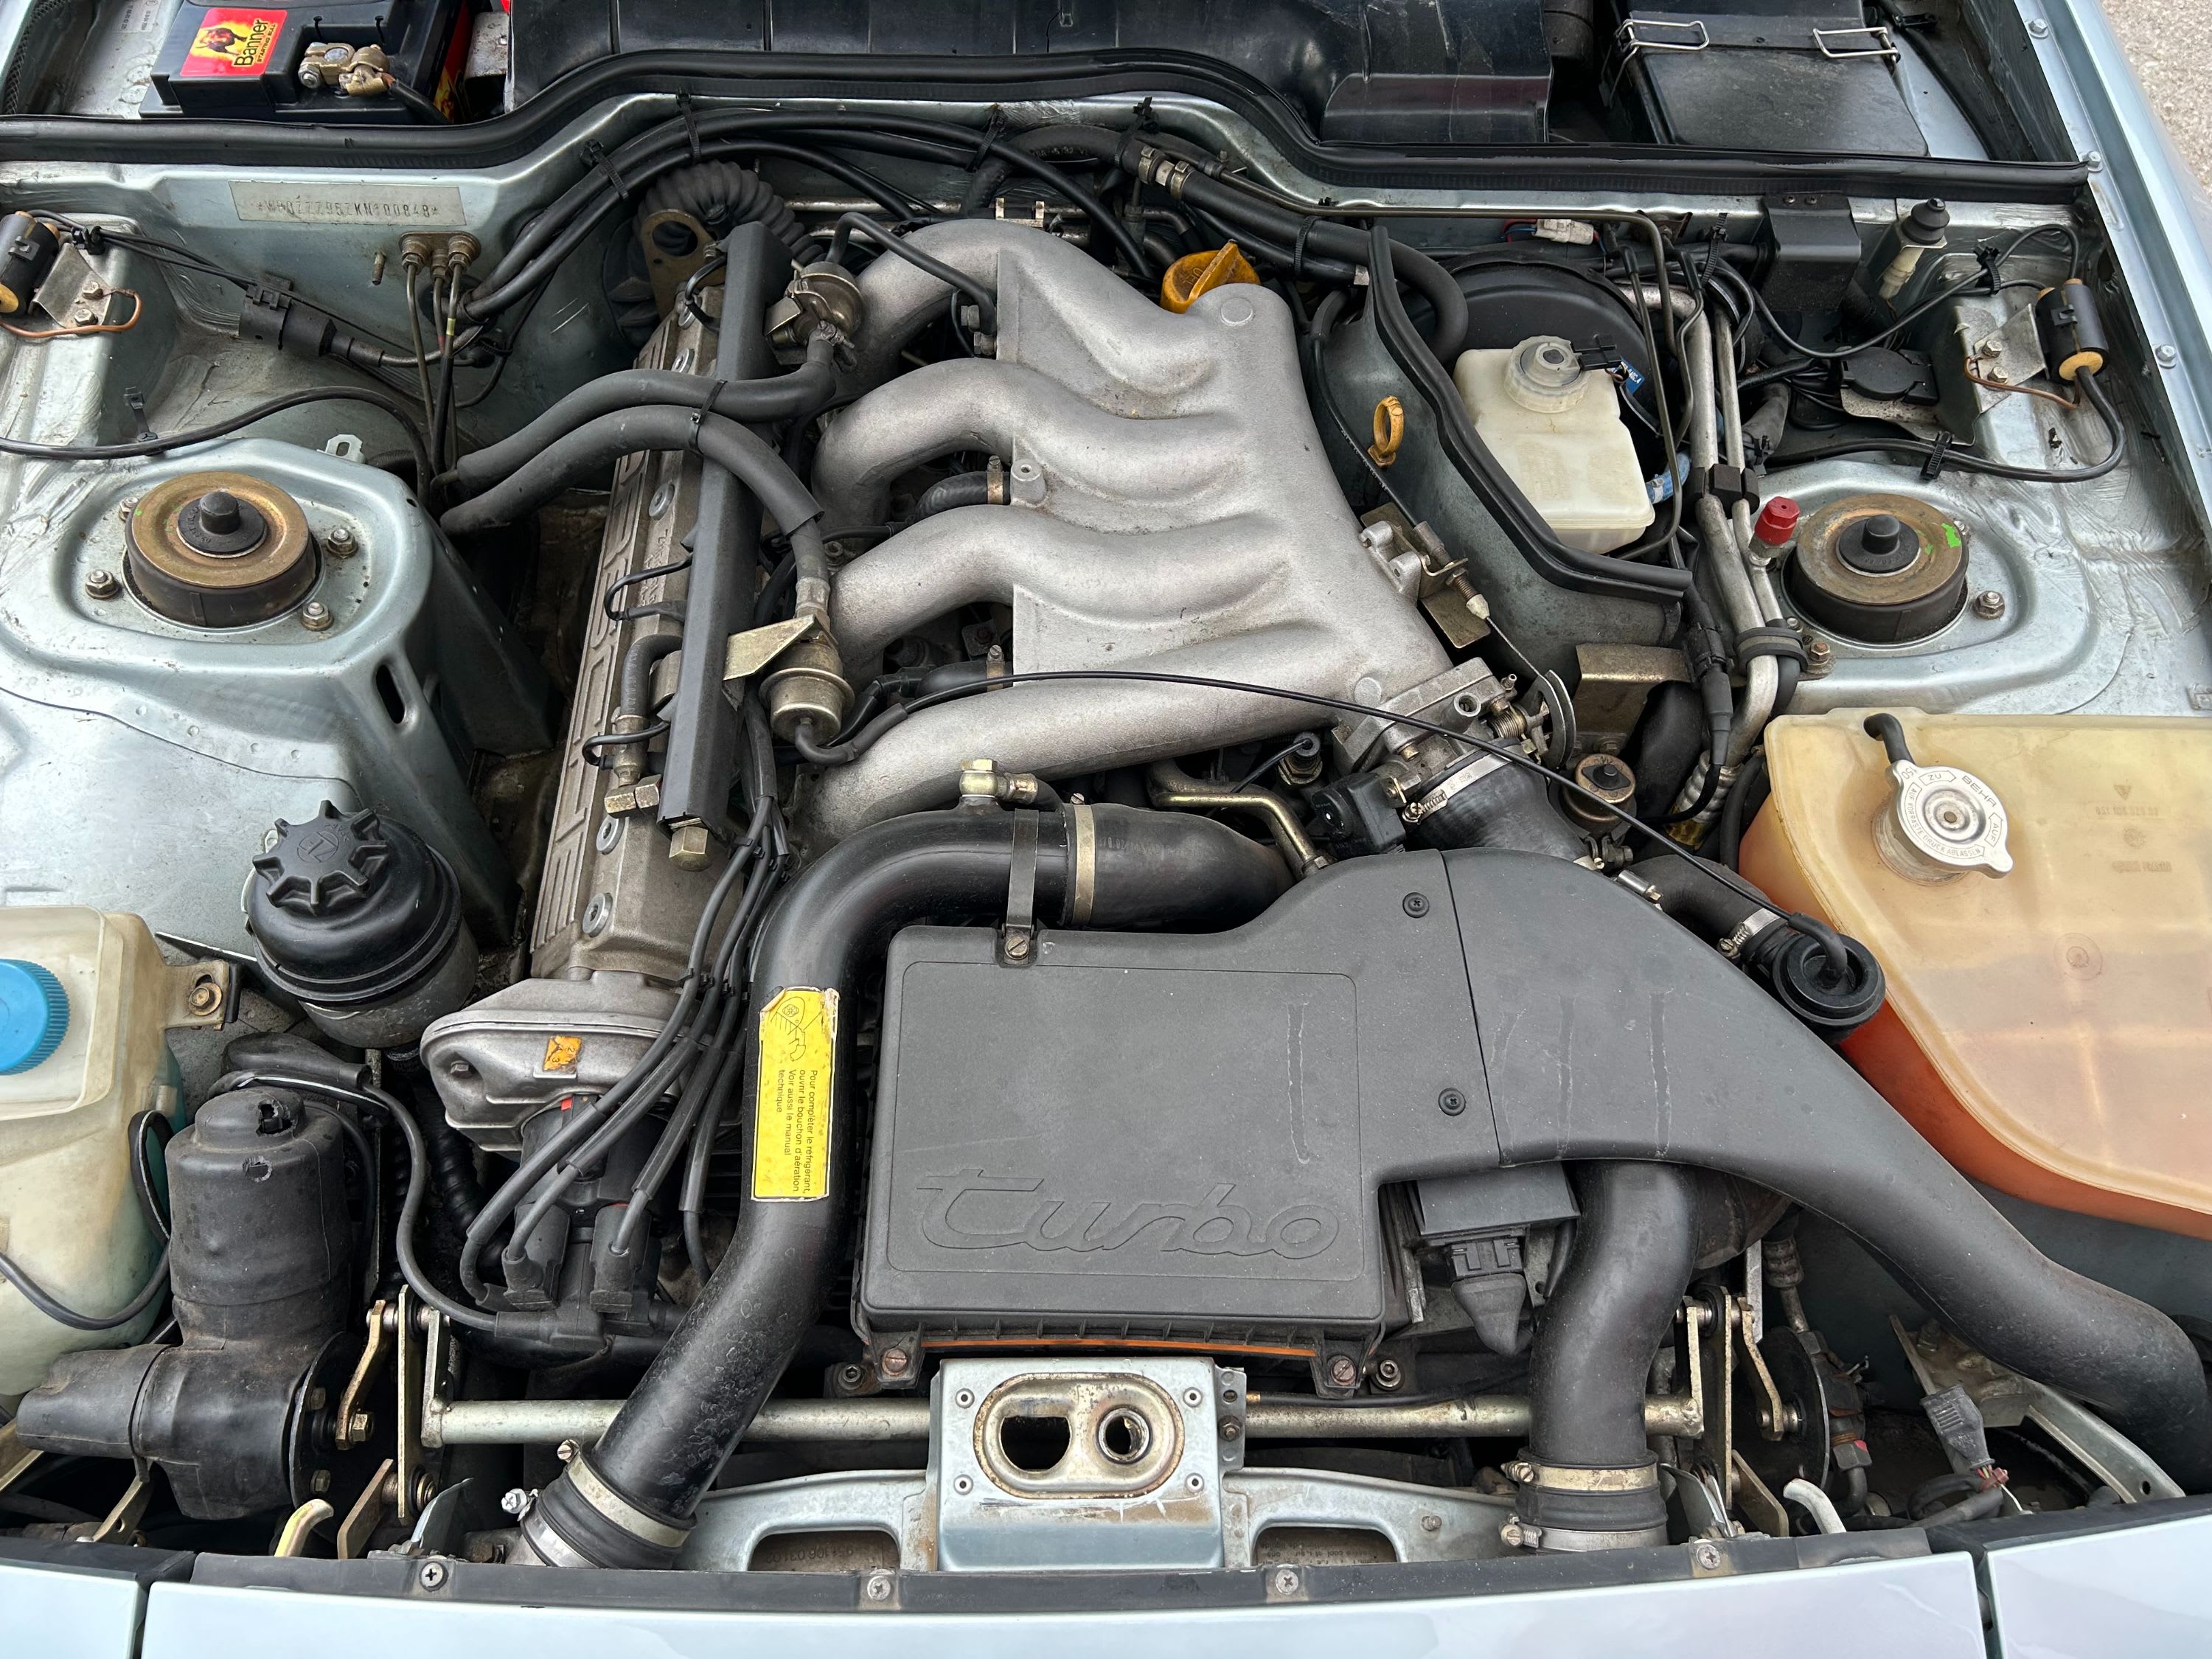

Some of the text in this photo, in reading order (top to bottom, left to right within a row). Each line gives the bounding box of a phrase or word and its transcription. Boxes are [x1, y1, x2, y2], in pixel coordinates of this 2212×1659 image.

[234, 19, 268, 66] Banner
[257, 24, 276, 62] STARTING BULL
[1961, 775, 1997, 807] BEHR
[1907, 787, 1981, 858] AUF VORRASTE DRUCK ABLASSEN
[1989, 822, 1999, 843] AUF
[776, 1069, 785, 1113] technique
[788, 1069, 796, 1086] Voir
[809, 1070, 818, 1090] Pour
[786, 1113, 794, 1121] le
[796, 1107, 806, 1145] bouchon
[784, 1123, 792, 1155] manual
[806, 1136, 815, 1144] le
